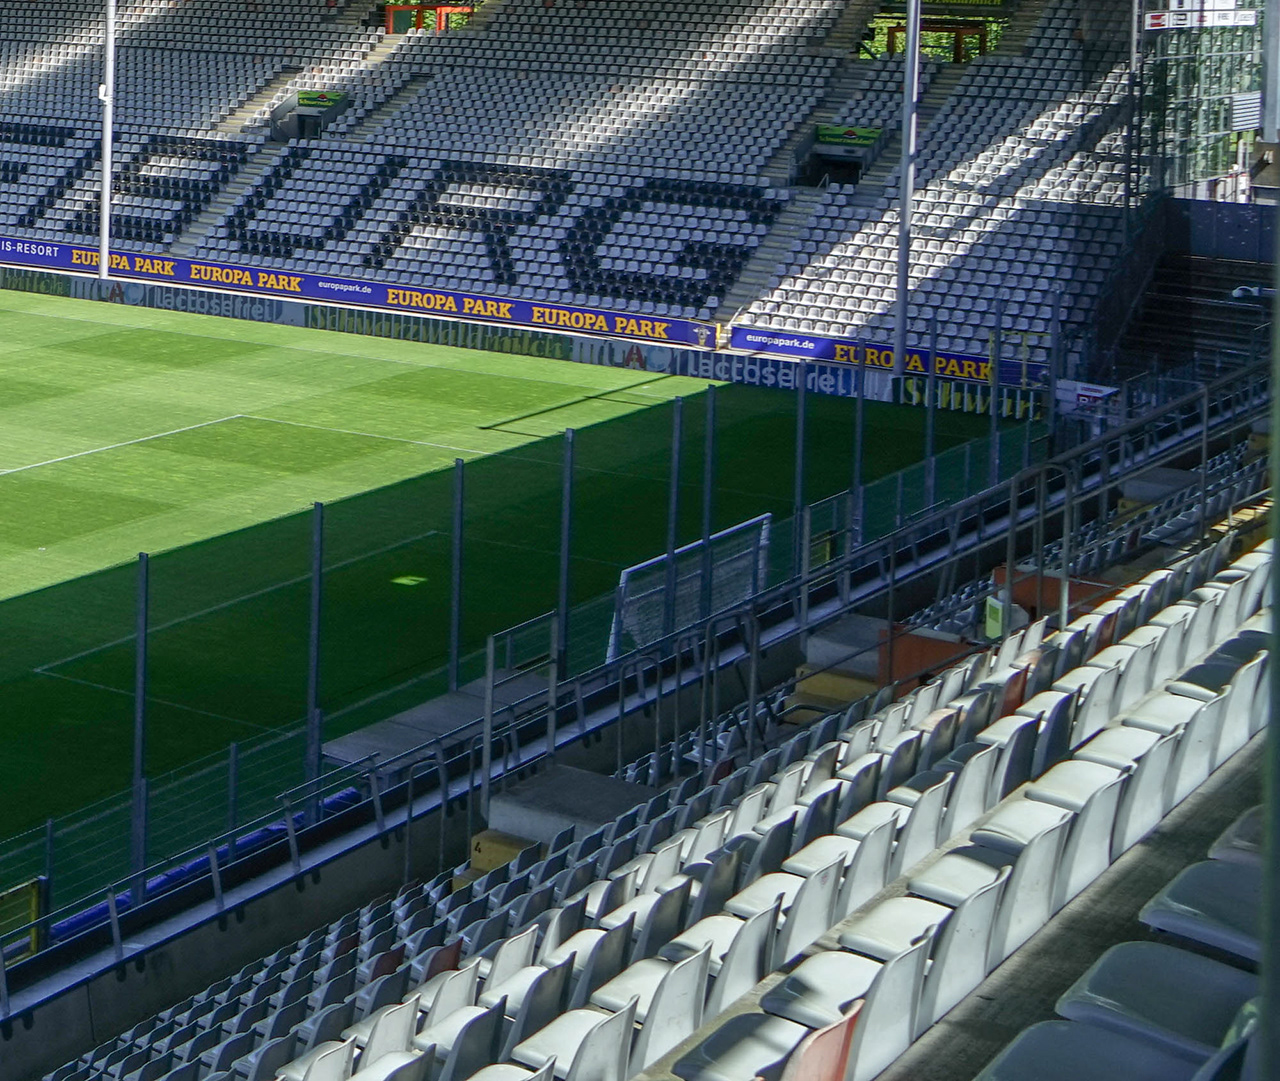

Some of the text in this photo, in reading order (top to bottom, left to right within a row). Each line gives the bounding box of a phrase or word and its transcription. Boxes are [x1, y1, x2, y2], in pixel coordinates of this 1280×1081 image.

[72, 248, 176, 276] EUROPA PARK
[190, 263, 303, 292] EUROPA PARK
[318, 281, 373, 294] europapark.de
[387, 289, 513, 319] EUROPA PARK
[531, 306, 670, 339] EUROPA PARK
[746, 332, 815, 351] europapark.de
[935, 357, 992, 381] PARK
[474, 841, 482, 854] 4
